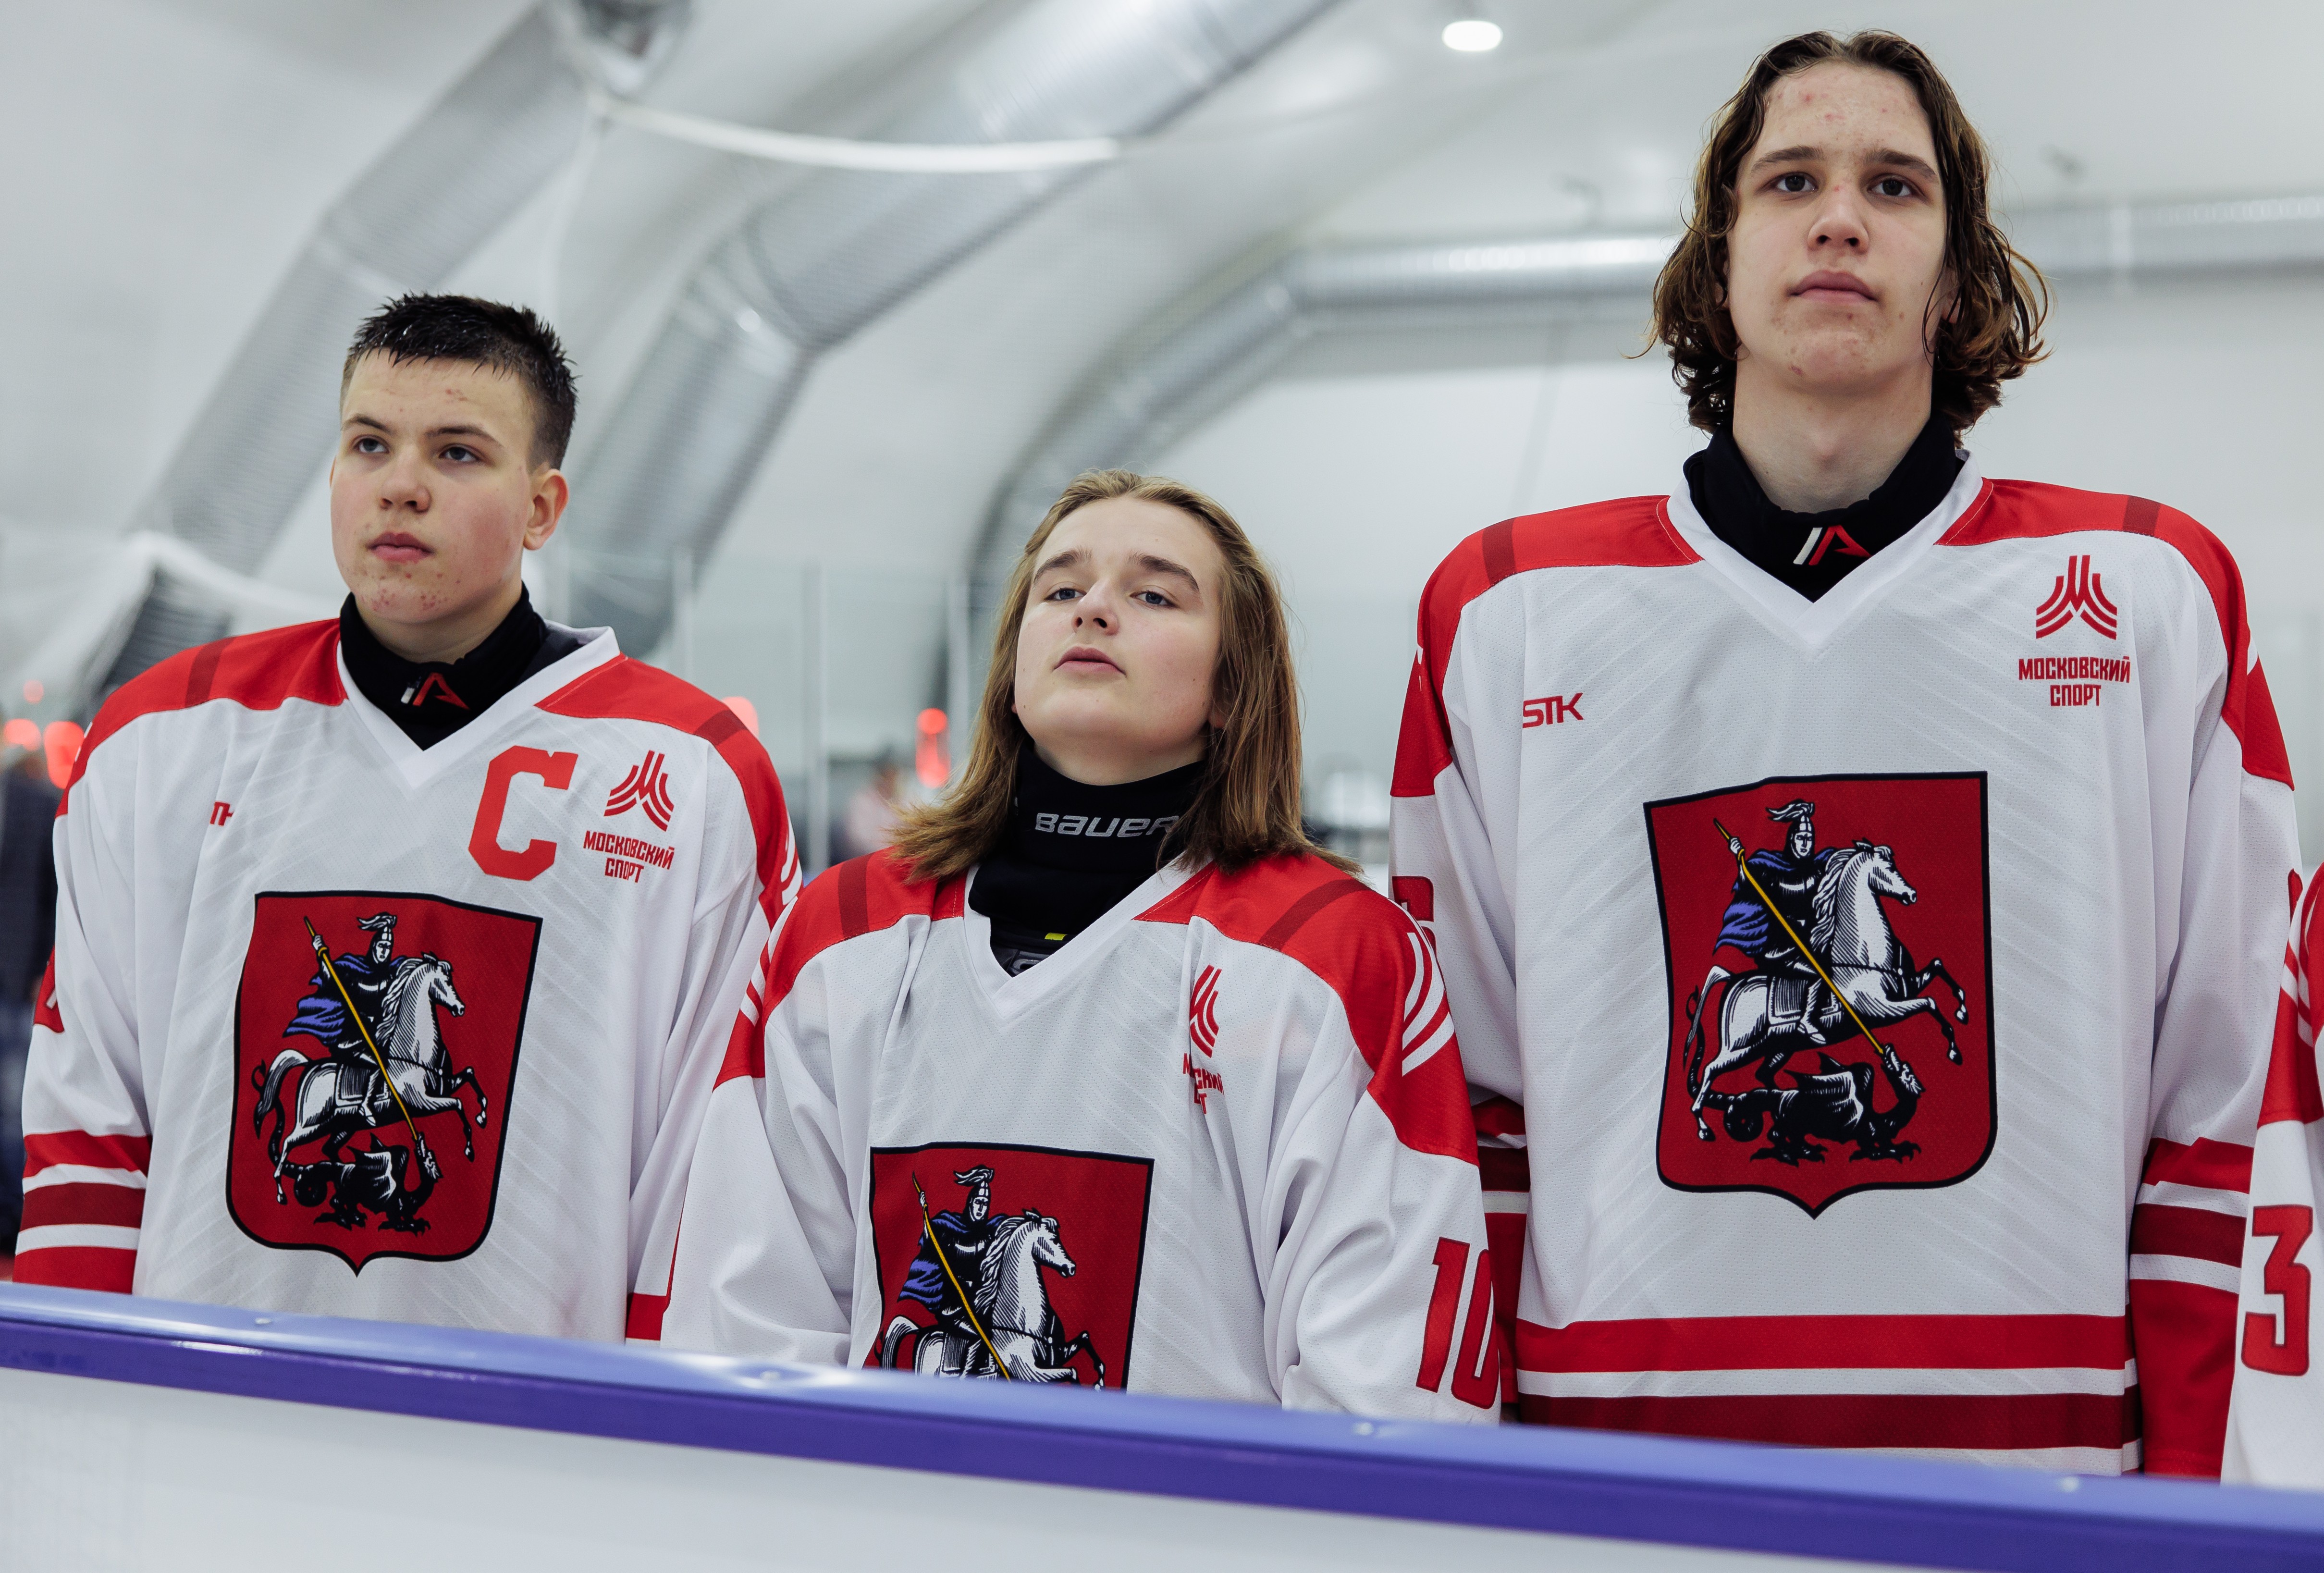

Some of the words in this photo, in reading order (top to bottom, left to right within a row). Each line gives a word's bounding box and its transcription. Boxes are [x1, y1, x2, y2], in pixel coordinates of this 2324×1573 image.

[2018, 655, 2130, 684] МОСКОВСКИЙ
[1522, 692, 1585, 728] STK
[2050, 684, 2102, 707] СПОРТ
[468, 745, 578, 882] C
[583, 830, 675, 870] МОСКОВСКИЙ
[604, 857, 645, 883] СПОРТ
[2241, 1204, 2313, 1376] 3
[1416, 1236, 1500, 1410] 10
